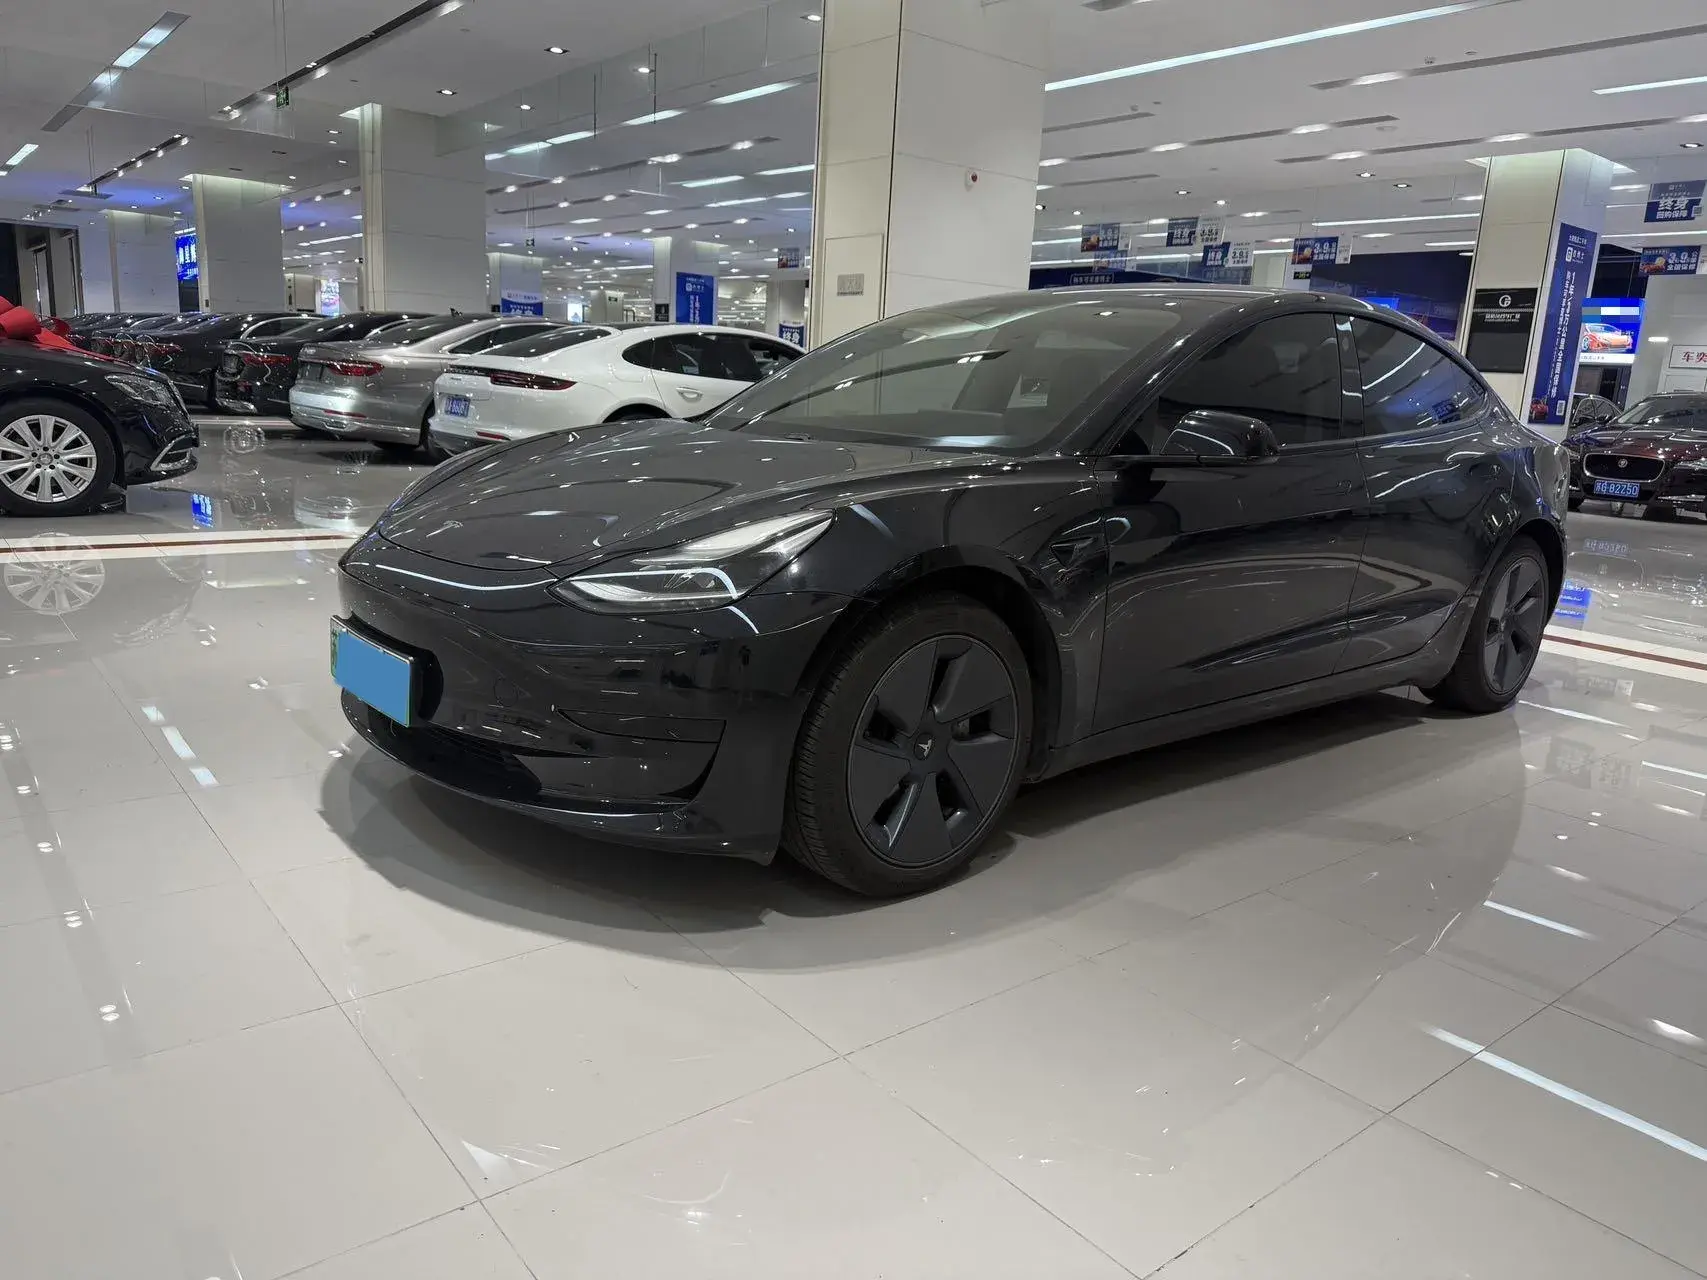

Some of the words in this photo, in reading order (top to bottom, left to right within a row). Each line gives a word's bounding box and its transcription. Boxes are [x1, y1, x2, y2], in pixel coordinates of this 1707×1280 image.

[1658, 197, 1688, 210] 终身
[1656, 210, 1688, 219] 回购保障
[1667, 263, 1696, 271] 全国保修
